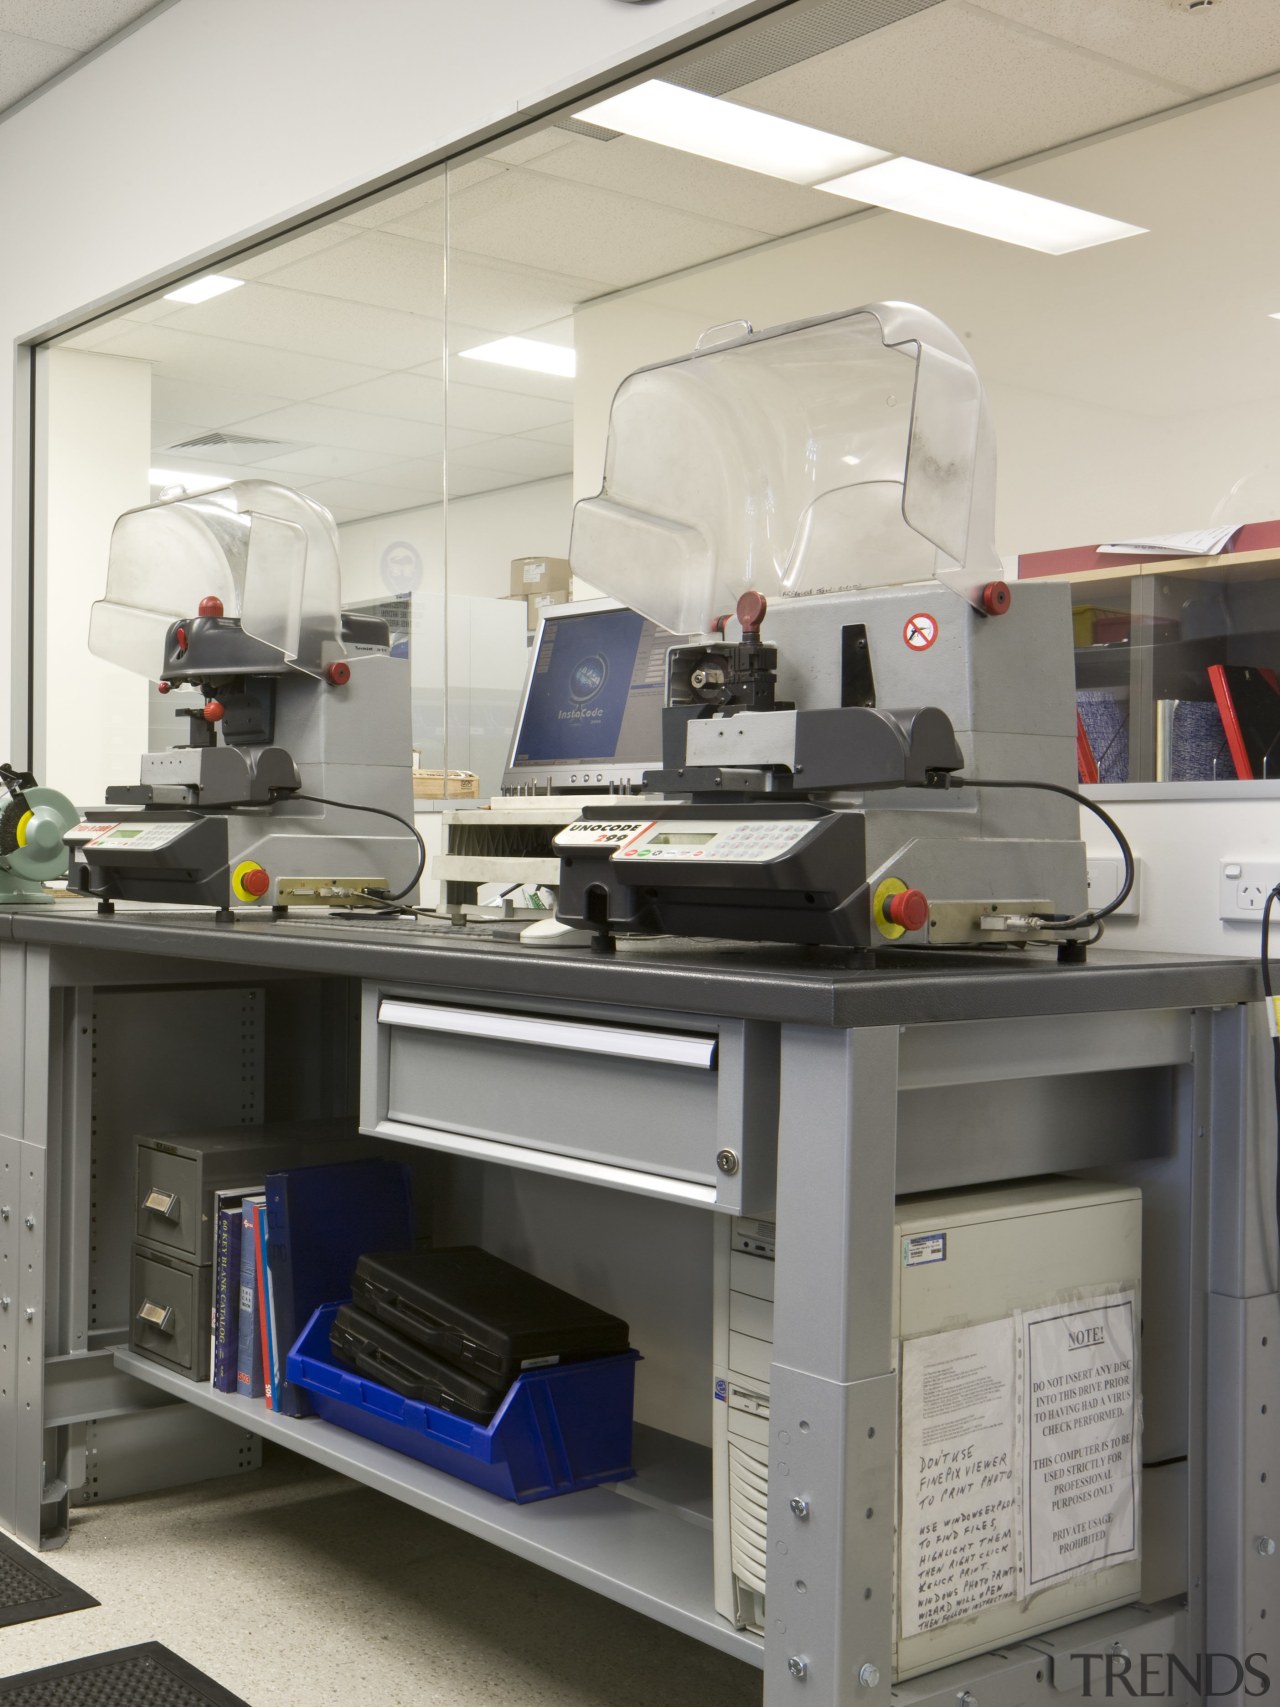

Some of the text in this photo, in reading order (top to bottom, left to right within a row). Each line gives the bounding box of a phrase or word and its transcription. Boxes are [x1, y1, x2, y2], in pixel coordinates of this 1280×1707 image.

[558, 708, 604, 720] InstaCode
[569, 824, 642, 832] UNOCODE
[593, 834, 629, 843] 299
[1068, 1326, 1104, 1348] NOTE!
[1033, 1360, 1131, 1393] DO NOT INSERT ANY DISC
[1036, 1375, 1130, 1408] INTO THIS DRIVE PRIOR
[1034, 1390, 1131, 1423] TO HAVING HAD A VIRUS
[1042, 1407, 1124, 1437] CHECK PERFORMED.
[920, 1444, 975, 1473] DON'T USE
[965, 1453, 1007, 1477] VIEWER
[1033, 1433, 1131, 1470] THIS COMPUTER IS TO BE
[1044, 1451, 1122, 1483] USED STRICTLY FOR
[919, 1469, 1013, 1510] TO PRINT PHOTO
[1054, 1469, 1112, 1495] PROFESSIONAL
[1052, 1483, 1114, 1511] PURPOSES ONLY
[919, 1521, 937, 1536] USE
[919, 1538, 931, 1550] TO
[936, 1530, 959, 1544] FIND
[1052, 1512, 1114, 1542] PRIVATE USAGE
[919, 1528, 1012, 1567] HIGHLIGHT THEM
[1059, 1530, 1106, 1555] PROHIBITED
[918, 1544, 1008, 1579] THEN RIGHT CLICK
[918, 1588, 958, 1608] WINDOWS
[963, 1578, 989, 1592] PHOTO
[918, 1583, 1004, 1620] WIZARD WILL OPEN
[918, 1618, 940, 1631] THEN
[941, 1606, 970, 1621] FOLLOW
